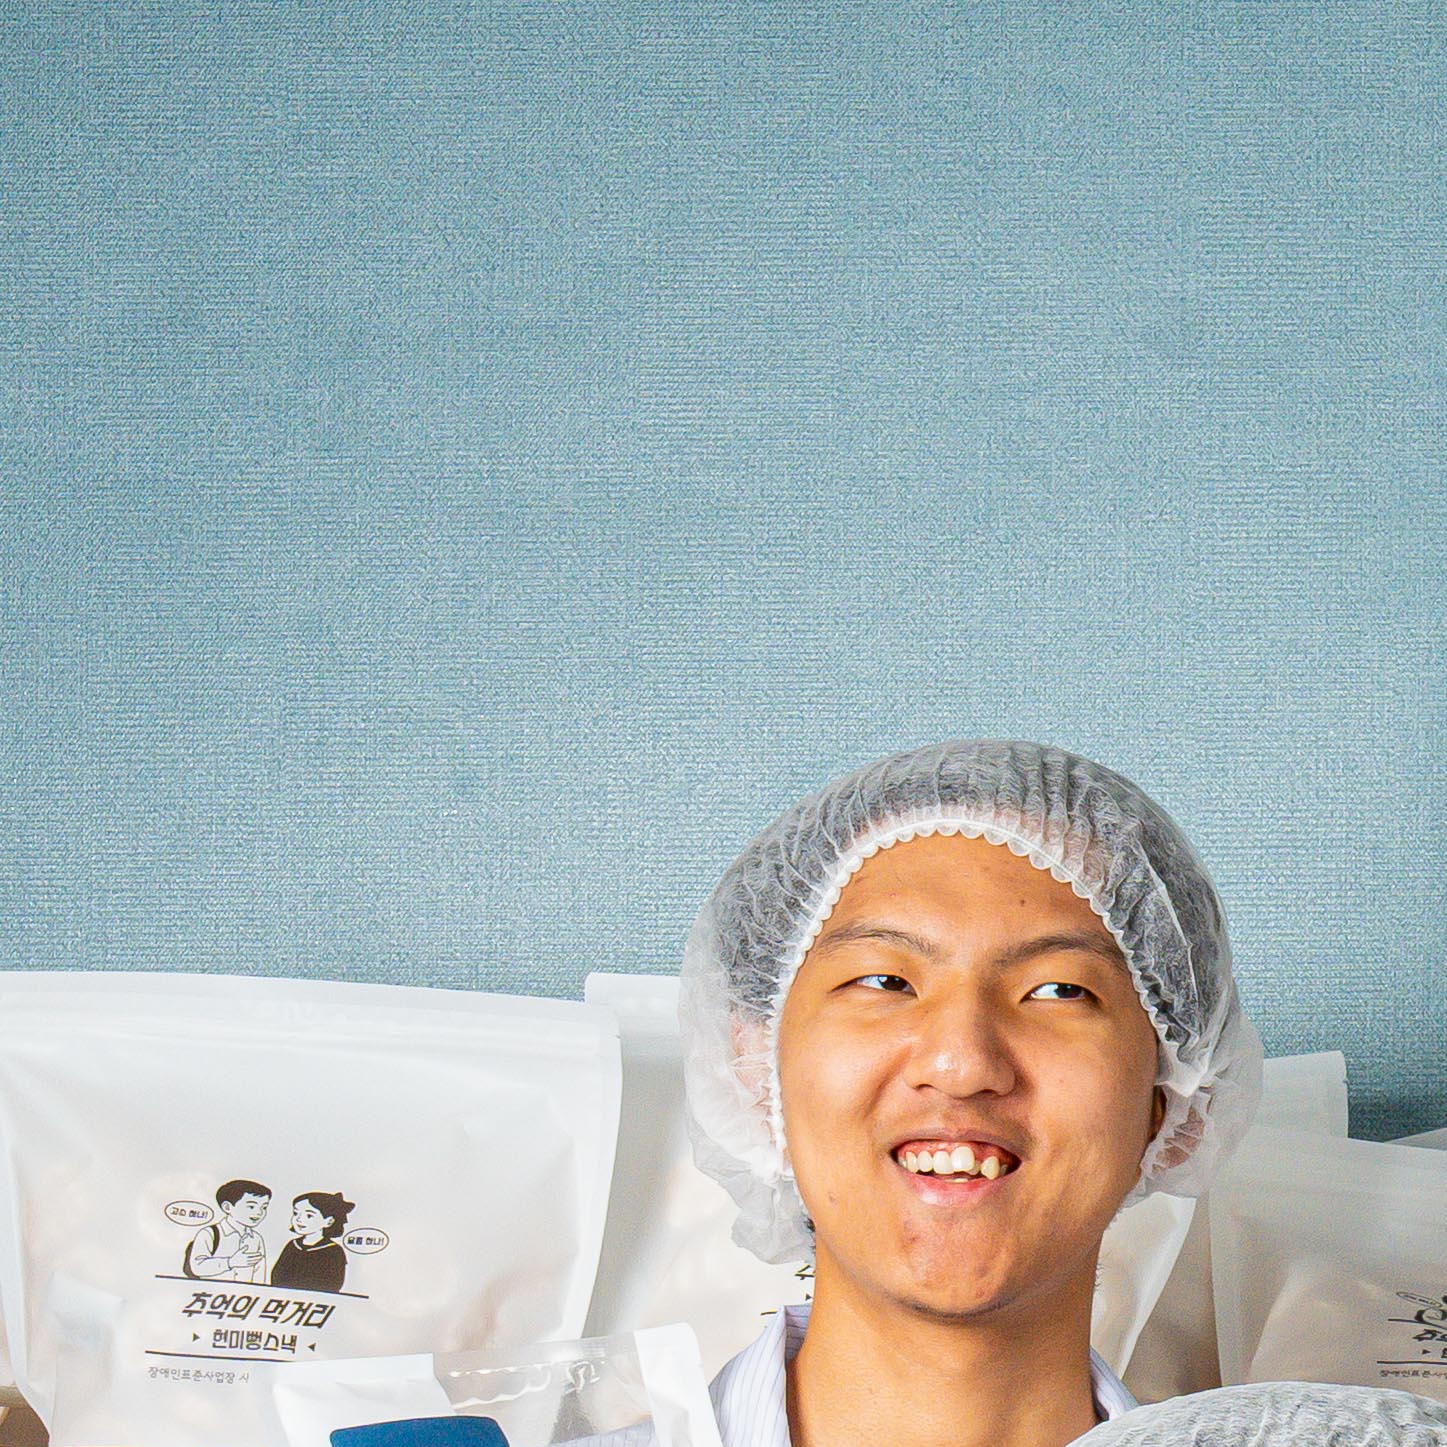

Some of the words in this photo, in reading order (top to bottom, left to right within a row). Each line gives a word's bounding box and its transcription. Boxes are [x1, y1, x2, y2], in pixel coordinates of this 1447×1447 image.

[182, 1291, 260, 1321] 추억의
[259, 1299, 336, 1329] 먹거리
[212, 1329, 298, 1354] 현미뻥스낵
[148, 1366, 235, 1384] 장애인표준사업장
